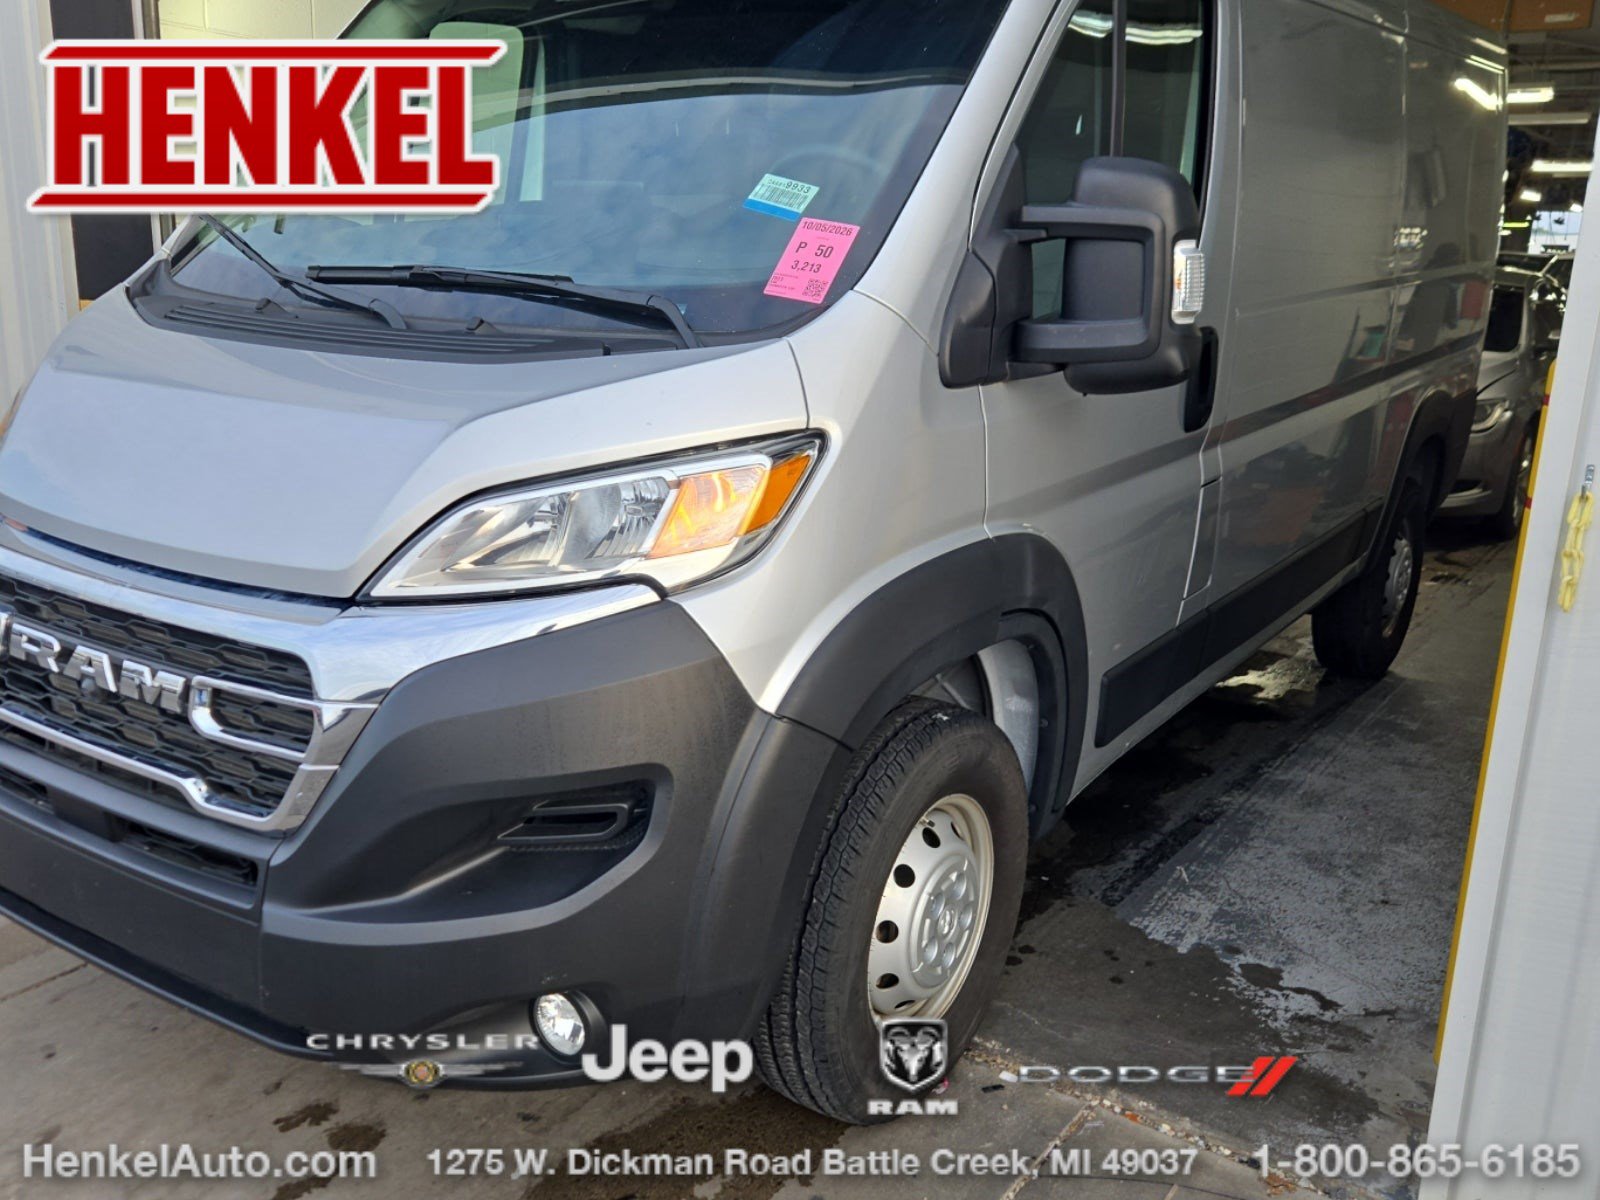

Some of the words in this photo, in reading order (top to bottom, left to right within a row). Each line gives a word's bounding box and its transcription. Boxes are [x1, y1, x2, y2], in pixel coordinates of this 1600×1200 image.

[802, 221, 853, 236] 10/05/2026
[795, 241, 808, 254] P
[814, 244, 834, 258] 50
[8, 622, 186, 714] RAM
